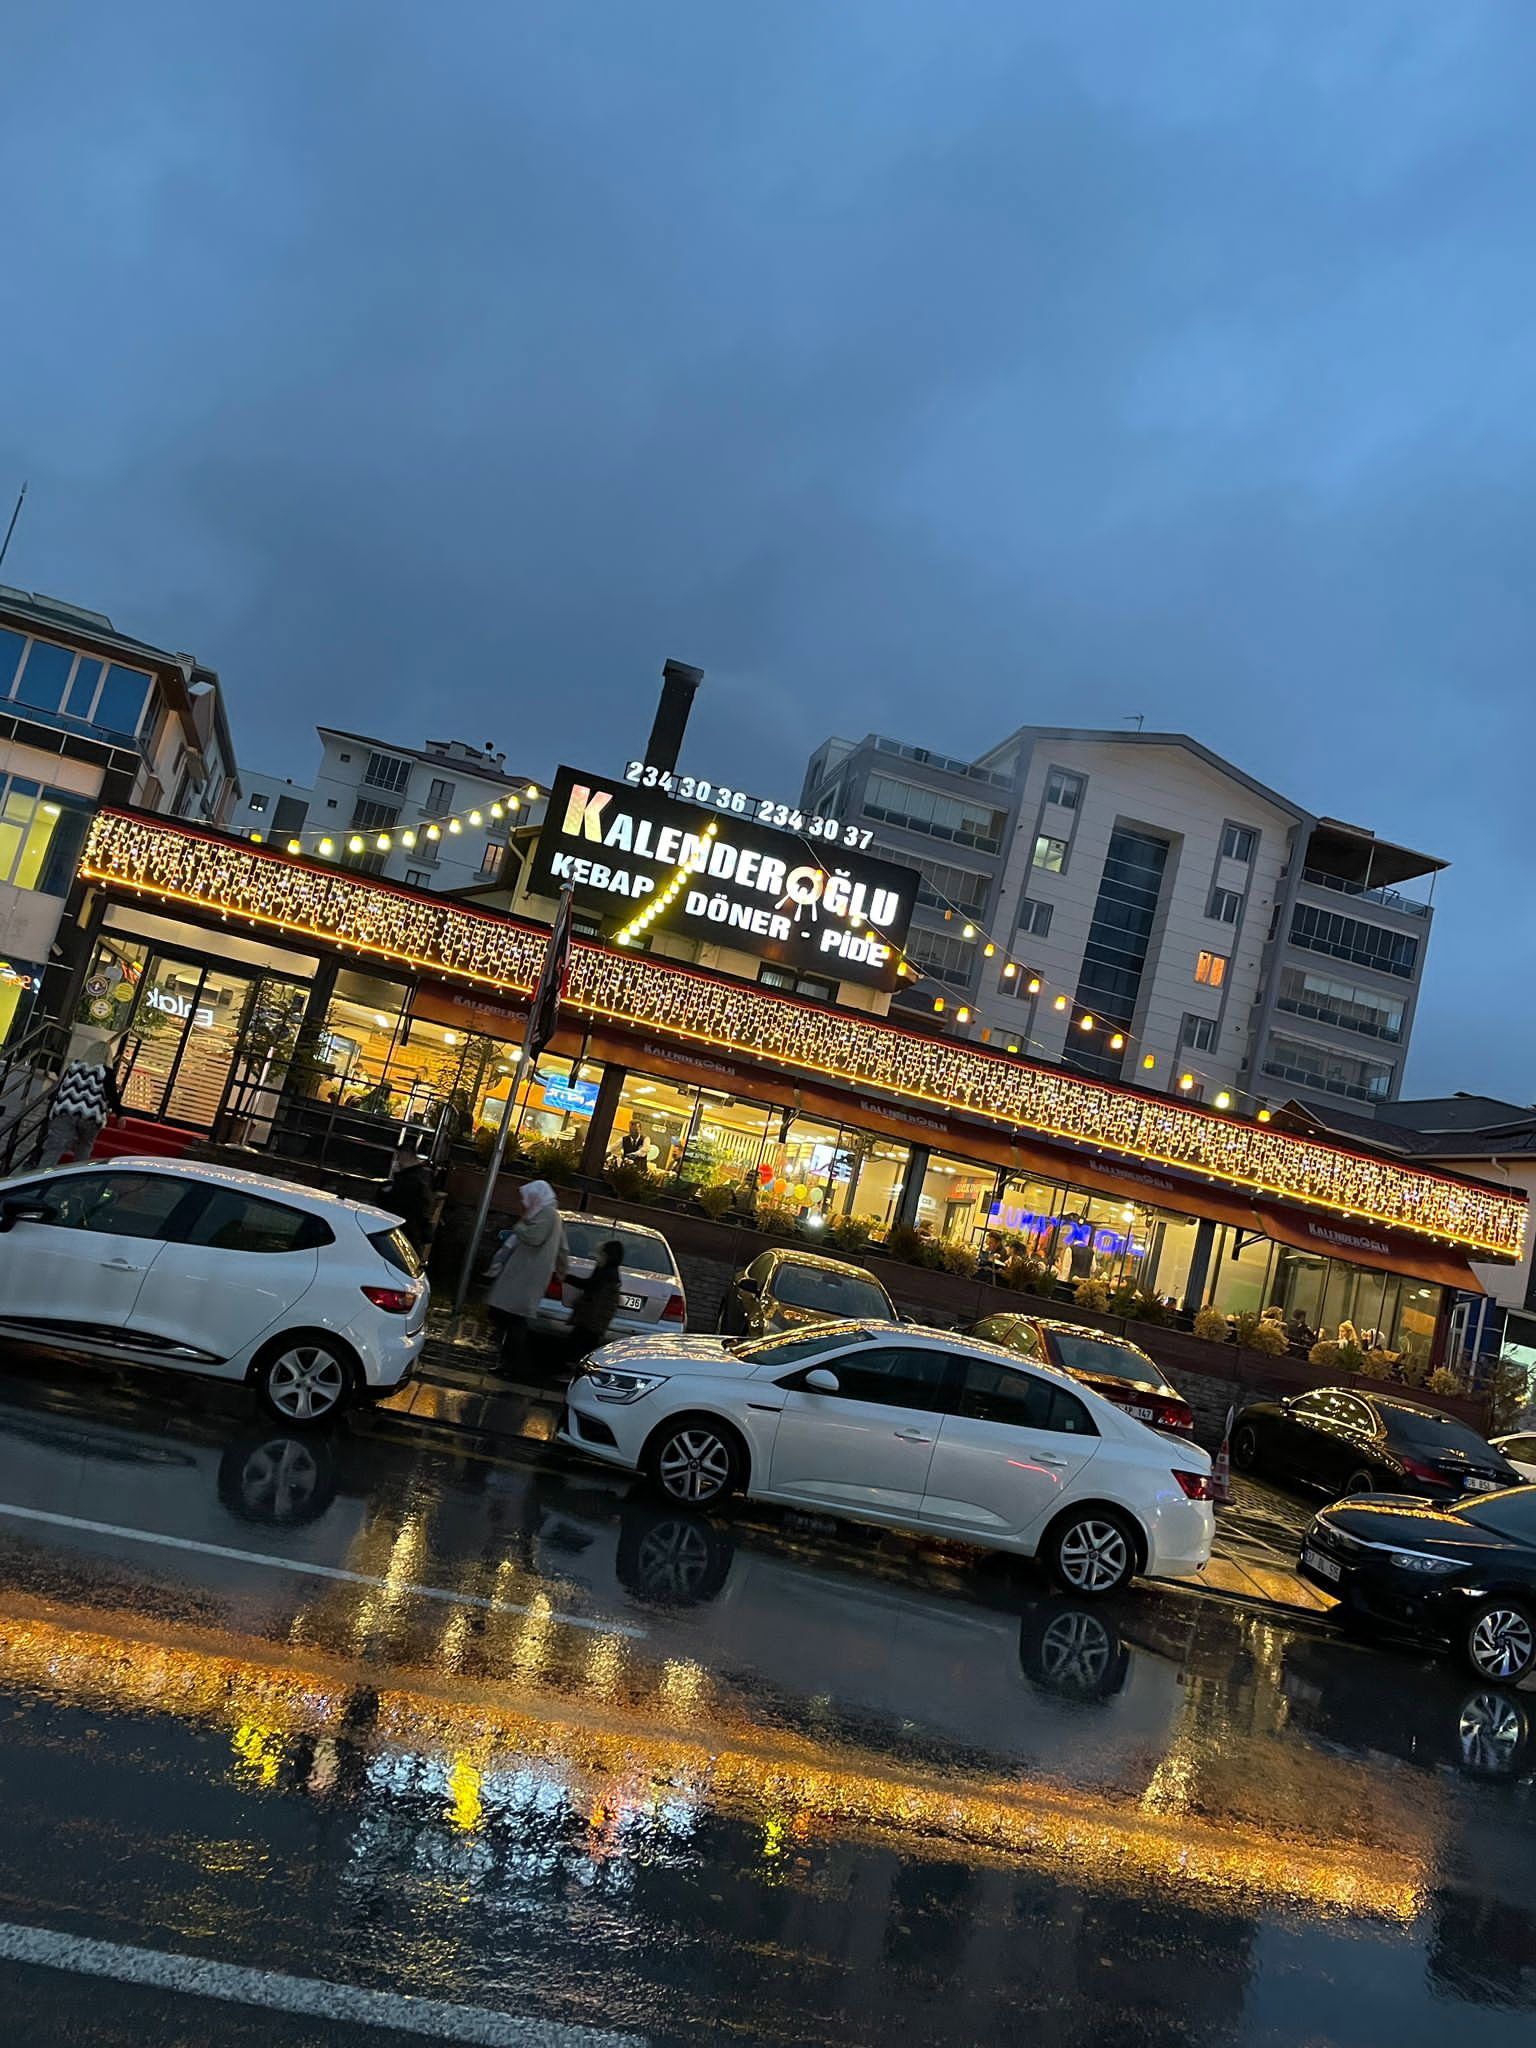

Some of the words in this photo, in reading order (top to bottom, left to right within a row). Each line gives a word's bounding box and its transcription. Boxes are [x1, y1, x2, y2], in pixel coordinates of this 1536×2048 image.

[561, 783, 899, 927] KALENDEROĞLU
[626, 761, 673, 791] 234
[680, 777, 711, 802] 30
[716, 788, 747, 813] 36
[758, 800, 803, 830] 234
[808, 815, 839, 840] 30
[843, 826, 874, 849] 37
[550, 852, 655, 898] KEBAP
[685, 890, 792, 941] DÖNER
[820, 929, 890, 968] PİDE
[453, 995, 530, 1021] KALENDERO
